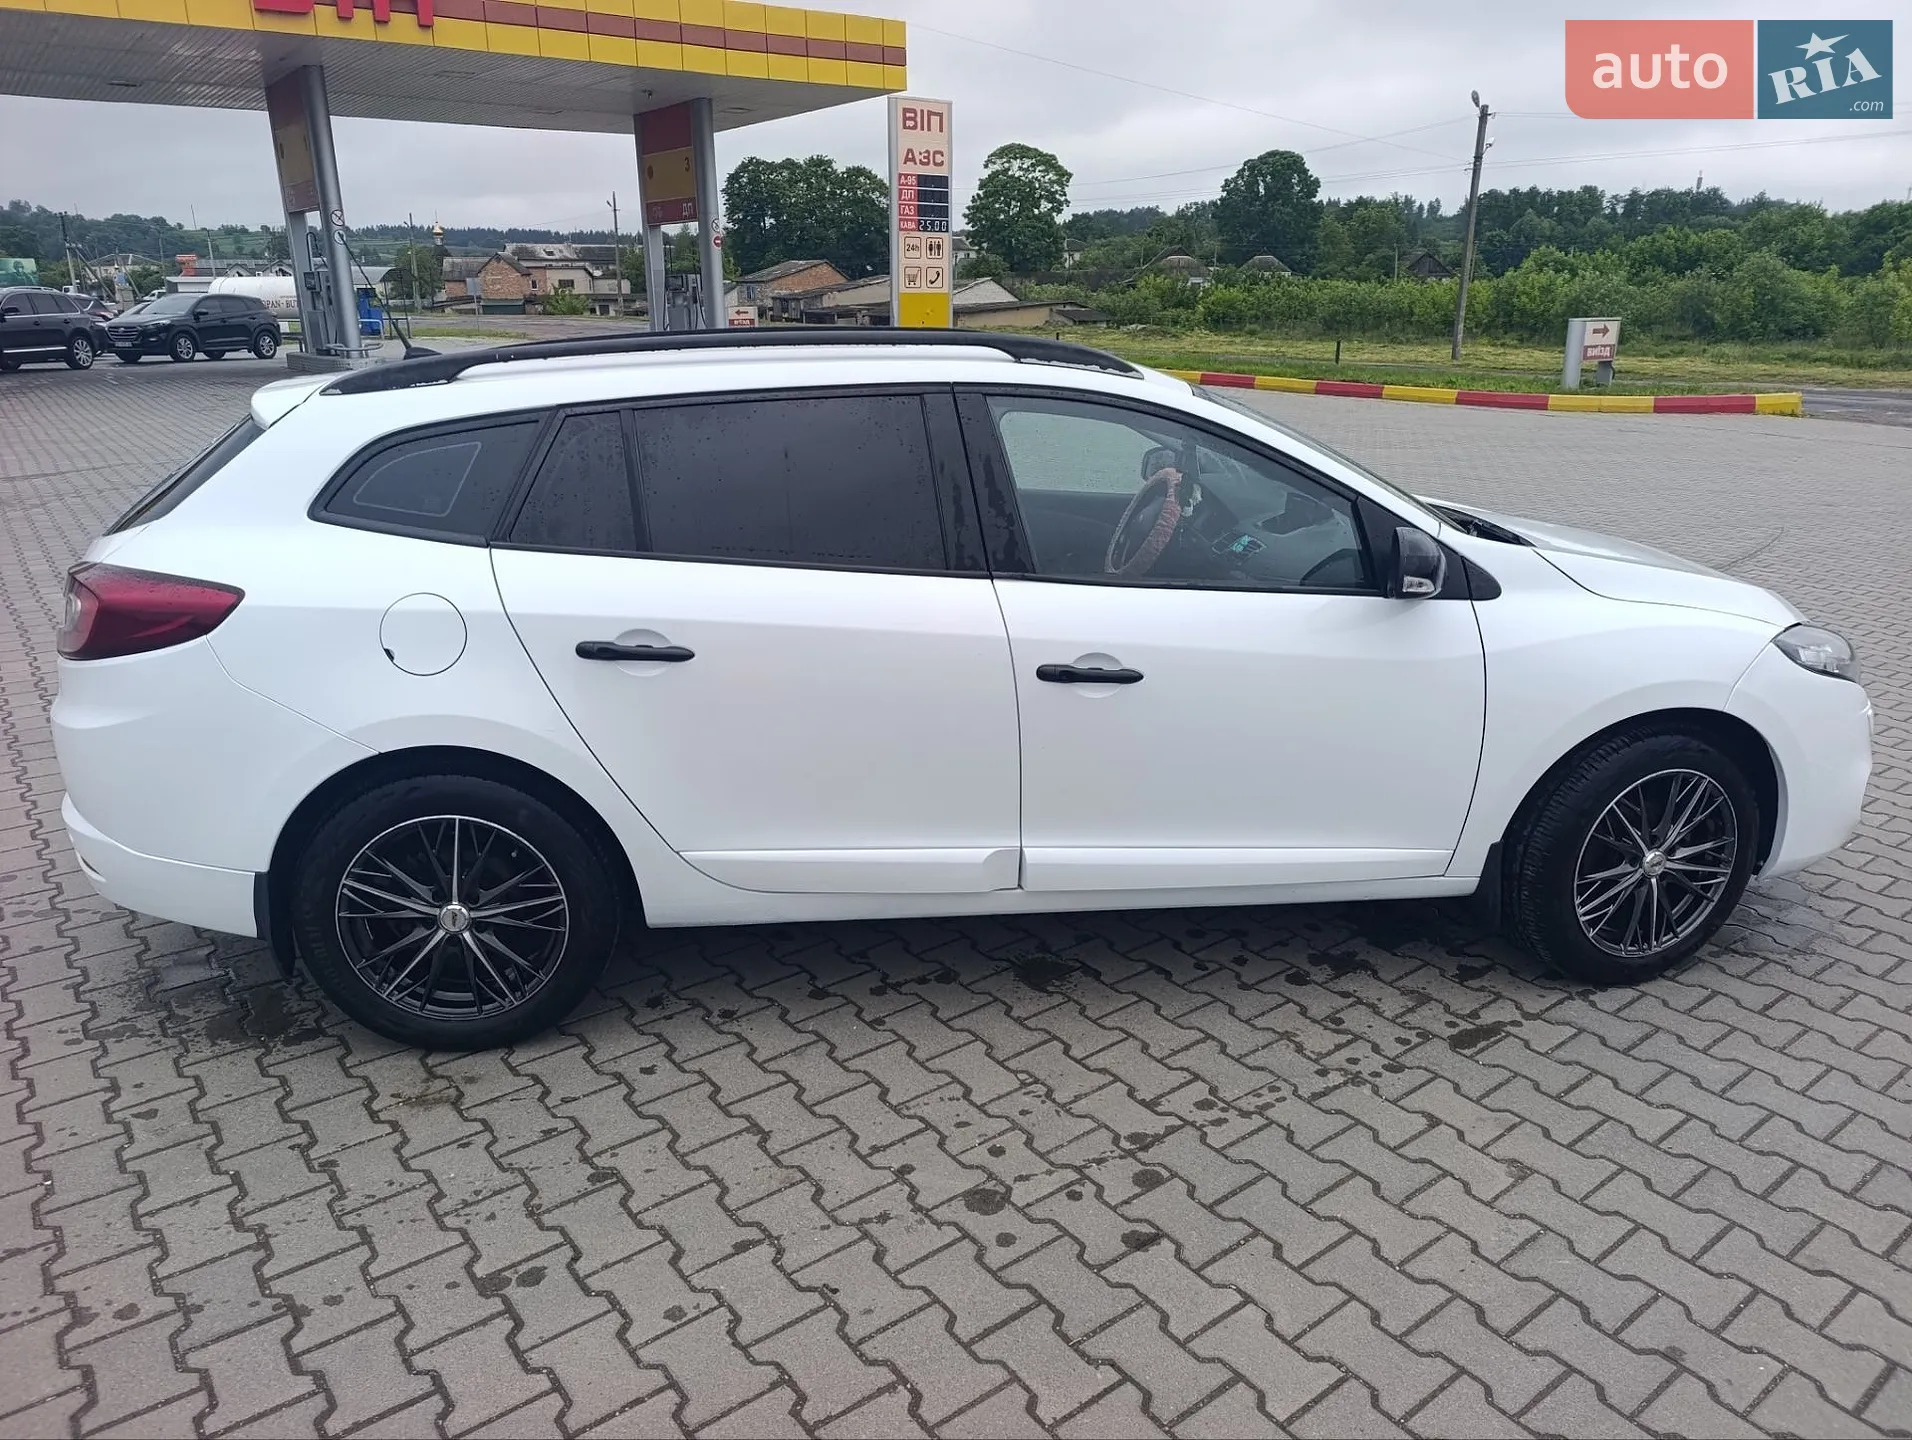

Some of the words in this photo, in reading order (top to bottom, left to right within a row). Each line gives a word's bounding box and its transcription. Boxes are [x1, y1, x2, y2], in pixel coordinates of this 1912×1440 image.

[902, 107, 943, 133] ВІП
[903, 148, 944, 167] АЗС
[900, 205, 914, 215] ГАЗ
[919, 220, 947, 232] 25.00
[906, 243, 920, 252] 24h
